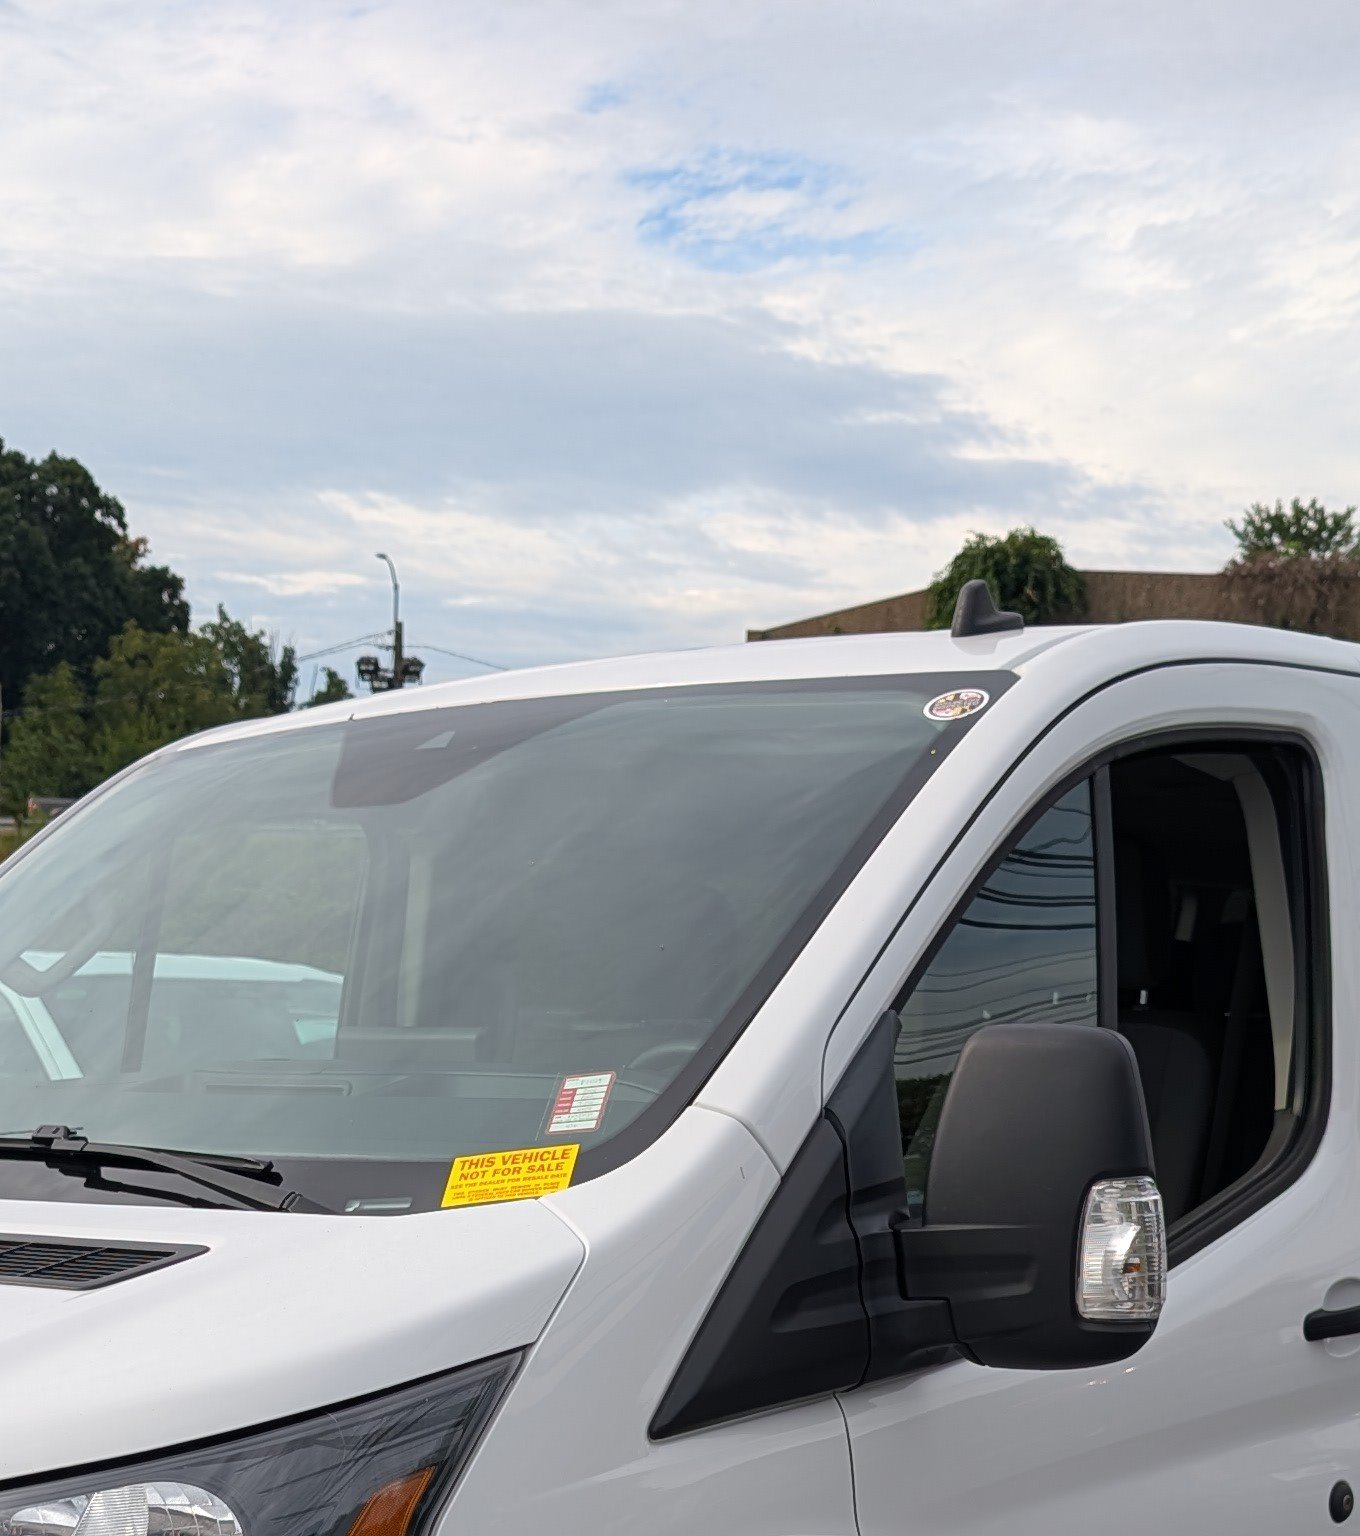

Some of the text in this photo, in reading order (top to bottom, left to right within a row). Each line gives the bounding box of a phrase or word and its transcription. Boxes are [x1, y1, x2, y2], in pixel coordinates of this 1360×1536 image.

[459, 1148, 572, 1171] THIS VEHICLE
[458, 1161, 565, 1181] NOT FOR SALE
